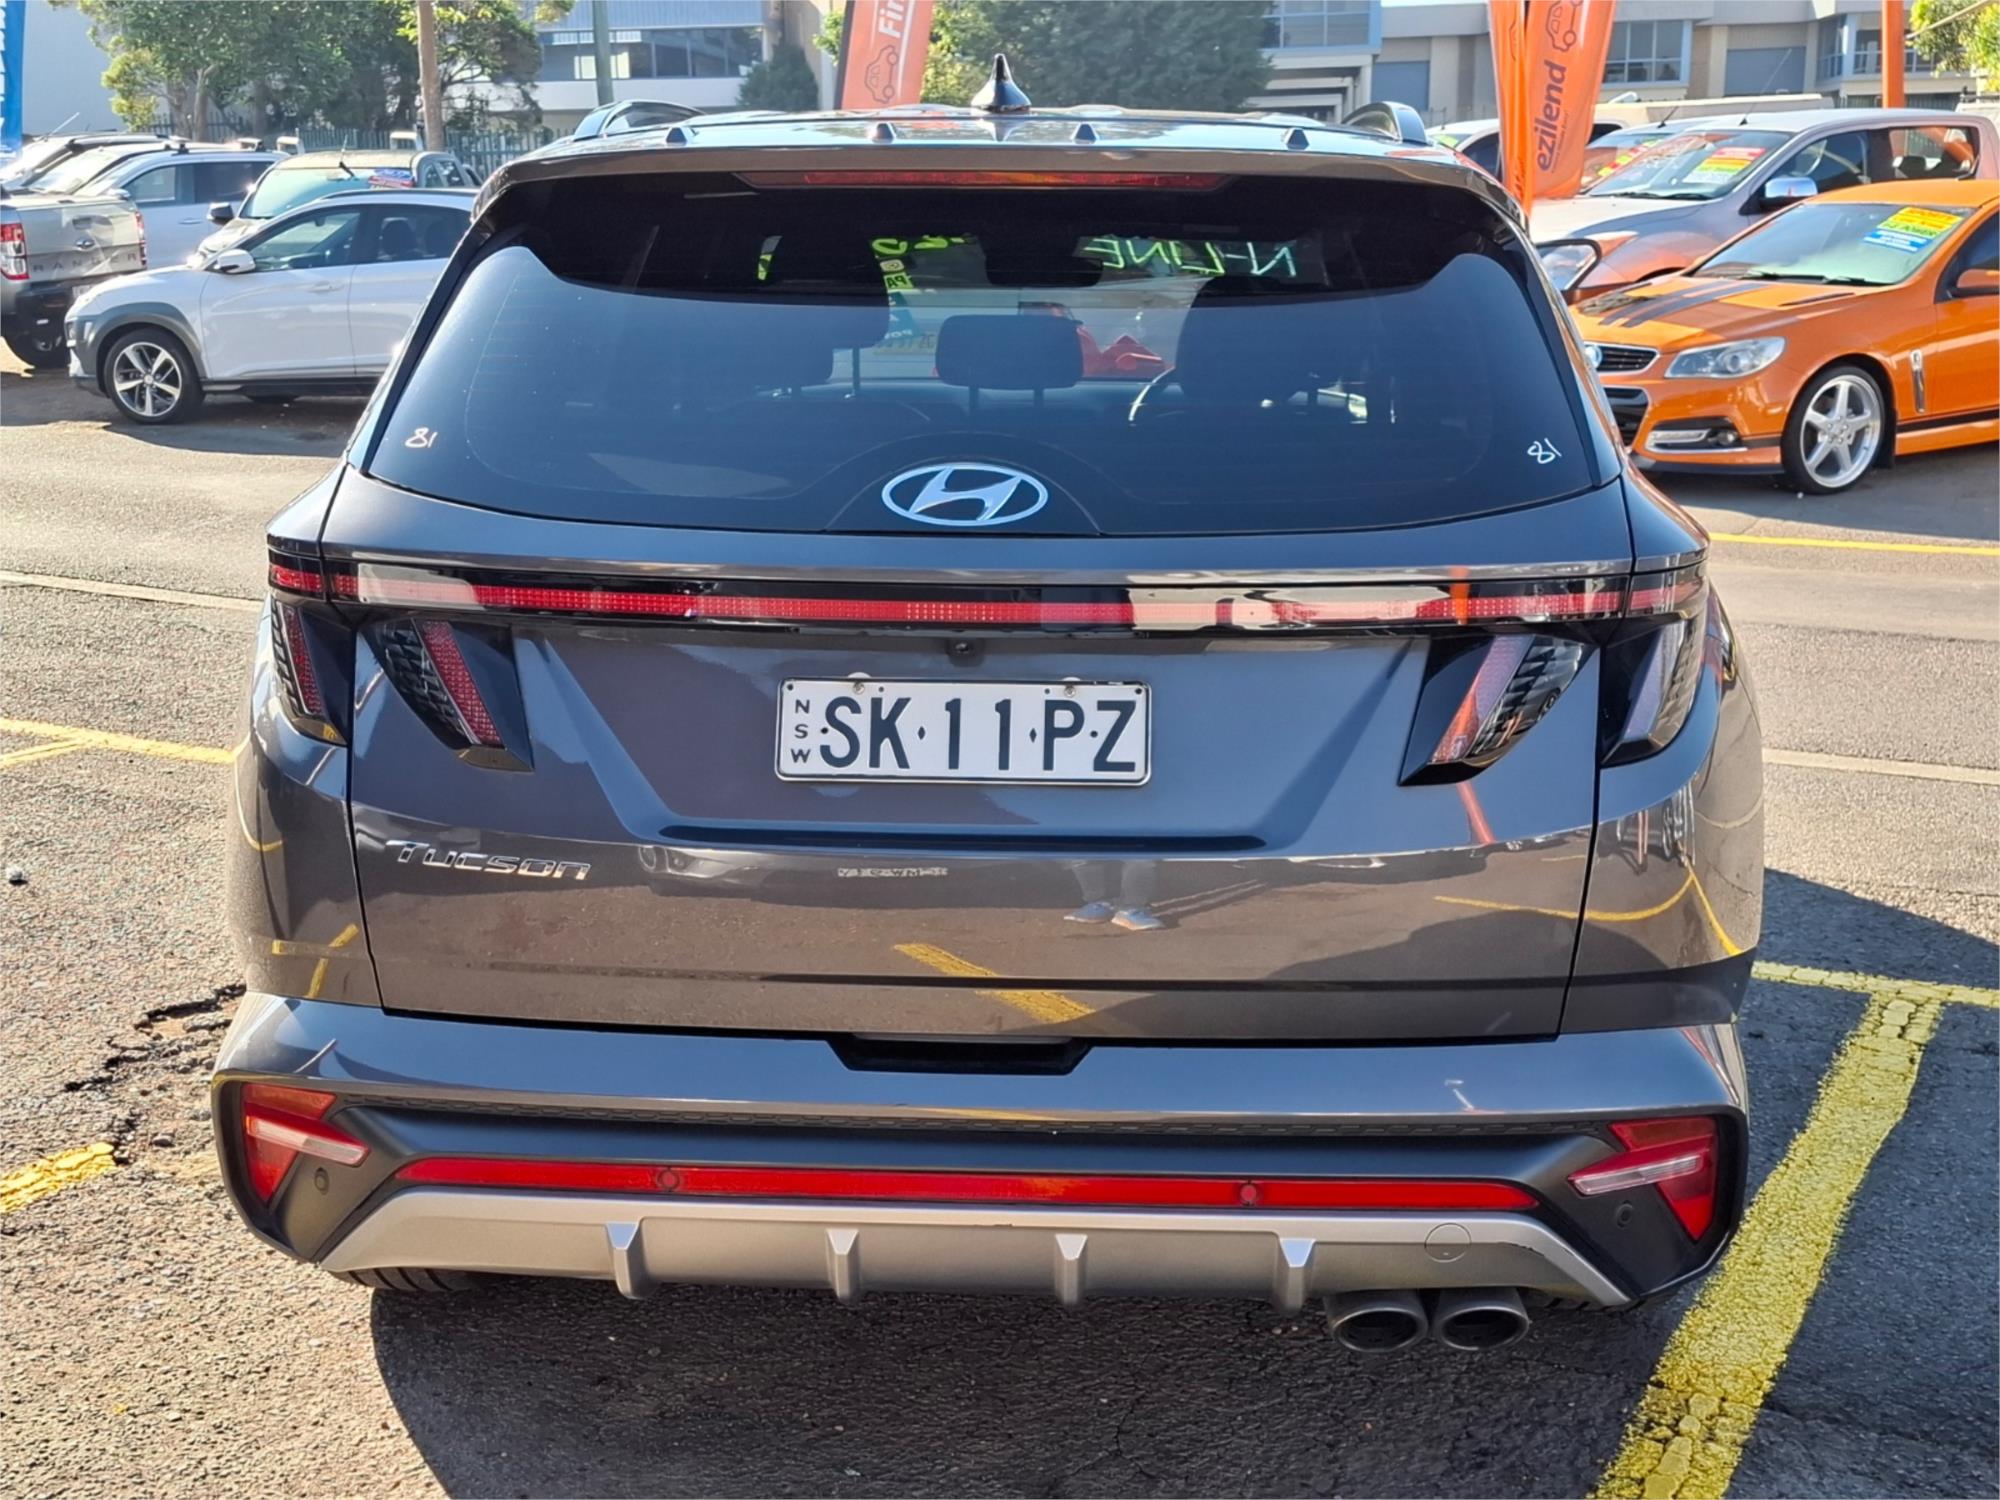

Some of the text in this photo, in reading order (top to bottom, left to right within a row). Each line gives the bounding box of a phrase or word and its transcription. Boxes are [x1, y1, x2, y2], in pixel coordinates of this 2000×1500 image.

[1534, 59, 1568, 171] ezilend
[33, 254, 137, 272] RANGER
[405, 427, 438, 448] 81
[1527, 438, 1562, 464] 81
[385, 839, 592, 881] TUCSON
